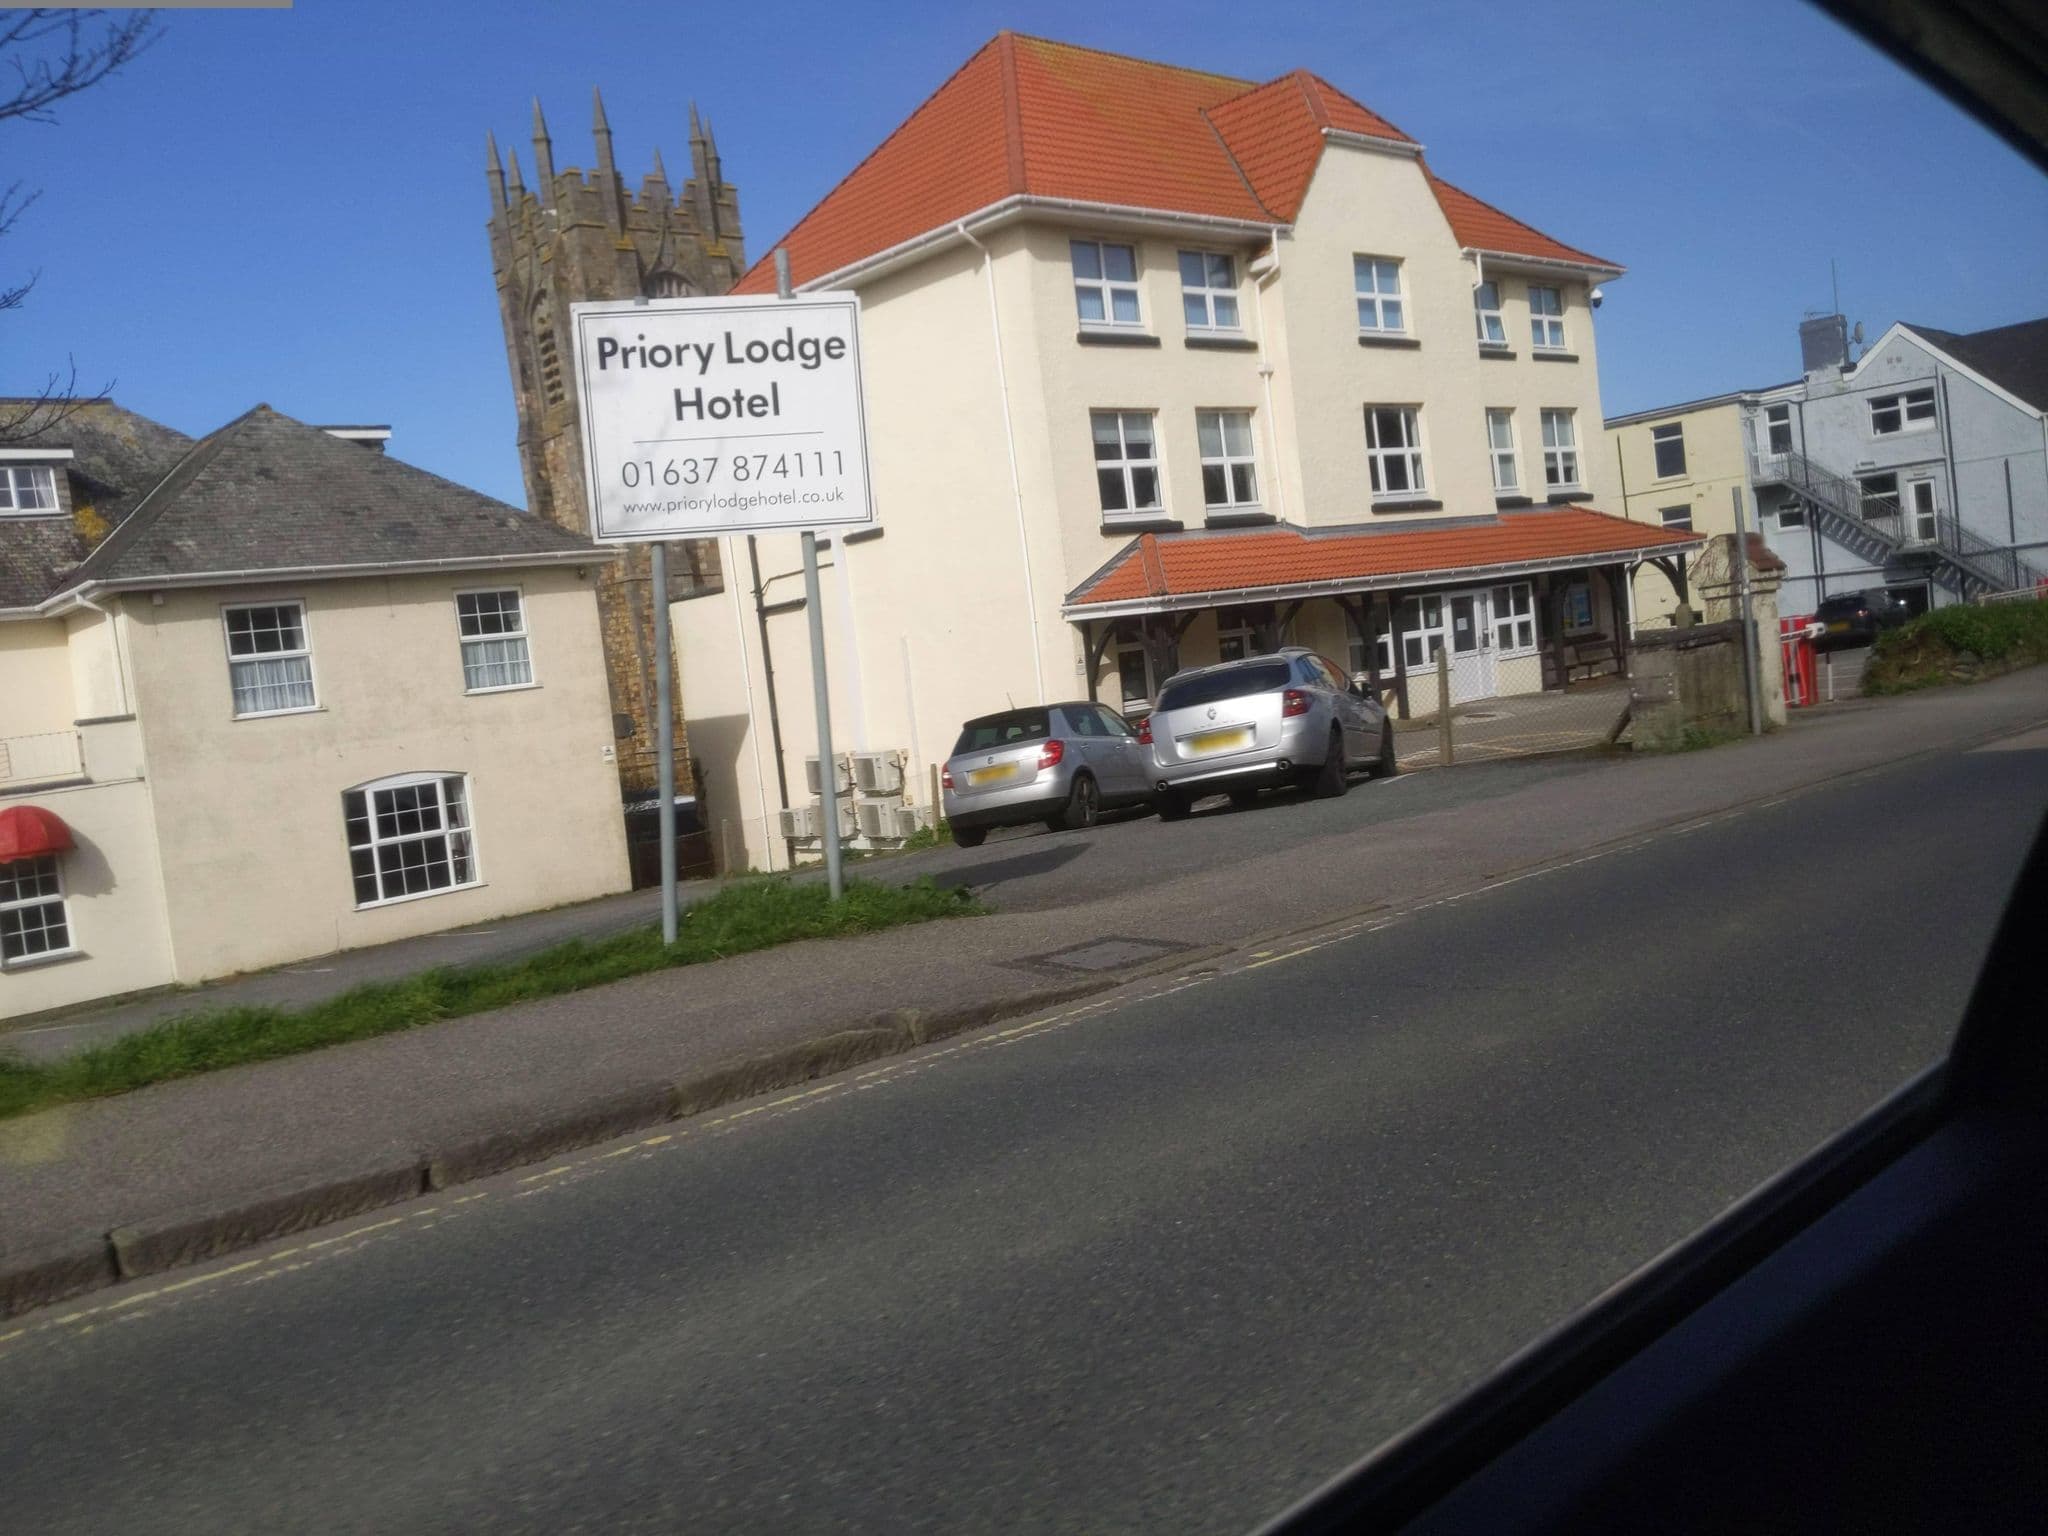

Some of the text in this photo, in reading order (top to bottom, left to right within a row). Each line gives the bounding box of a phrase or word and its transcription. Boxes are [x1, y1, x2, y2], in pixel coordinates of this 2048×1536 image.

[597, 327, 846, 375] Priory Lodge
[674, 381, 780, 421] Hotel
[622, 450, 843, 488] 01637 874111
[623, 487, 845, 514] www.priorylodgehotel.co.uk
